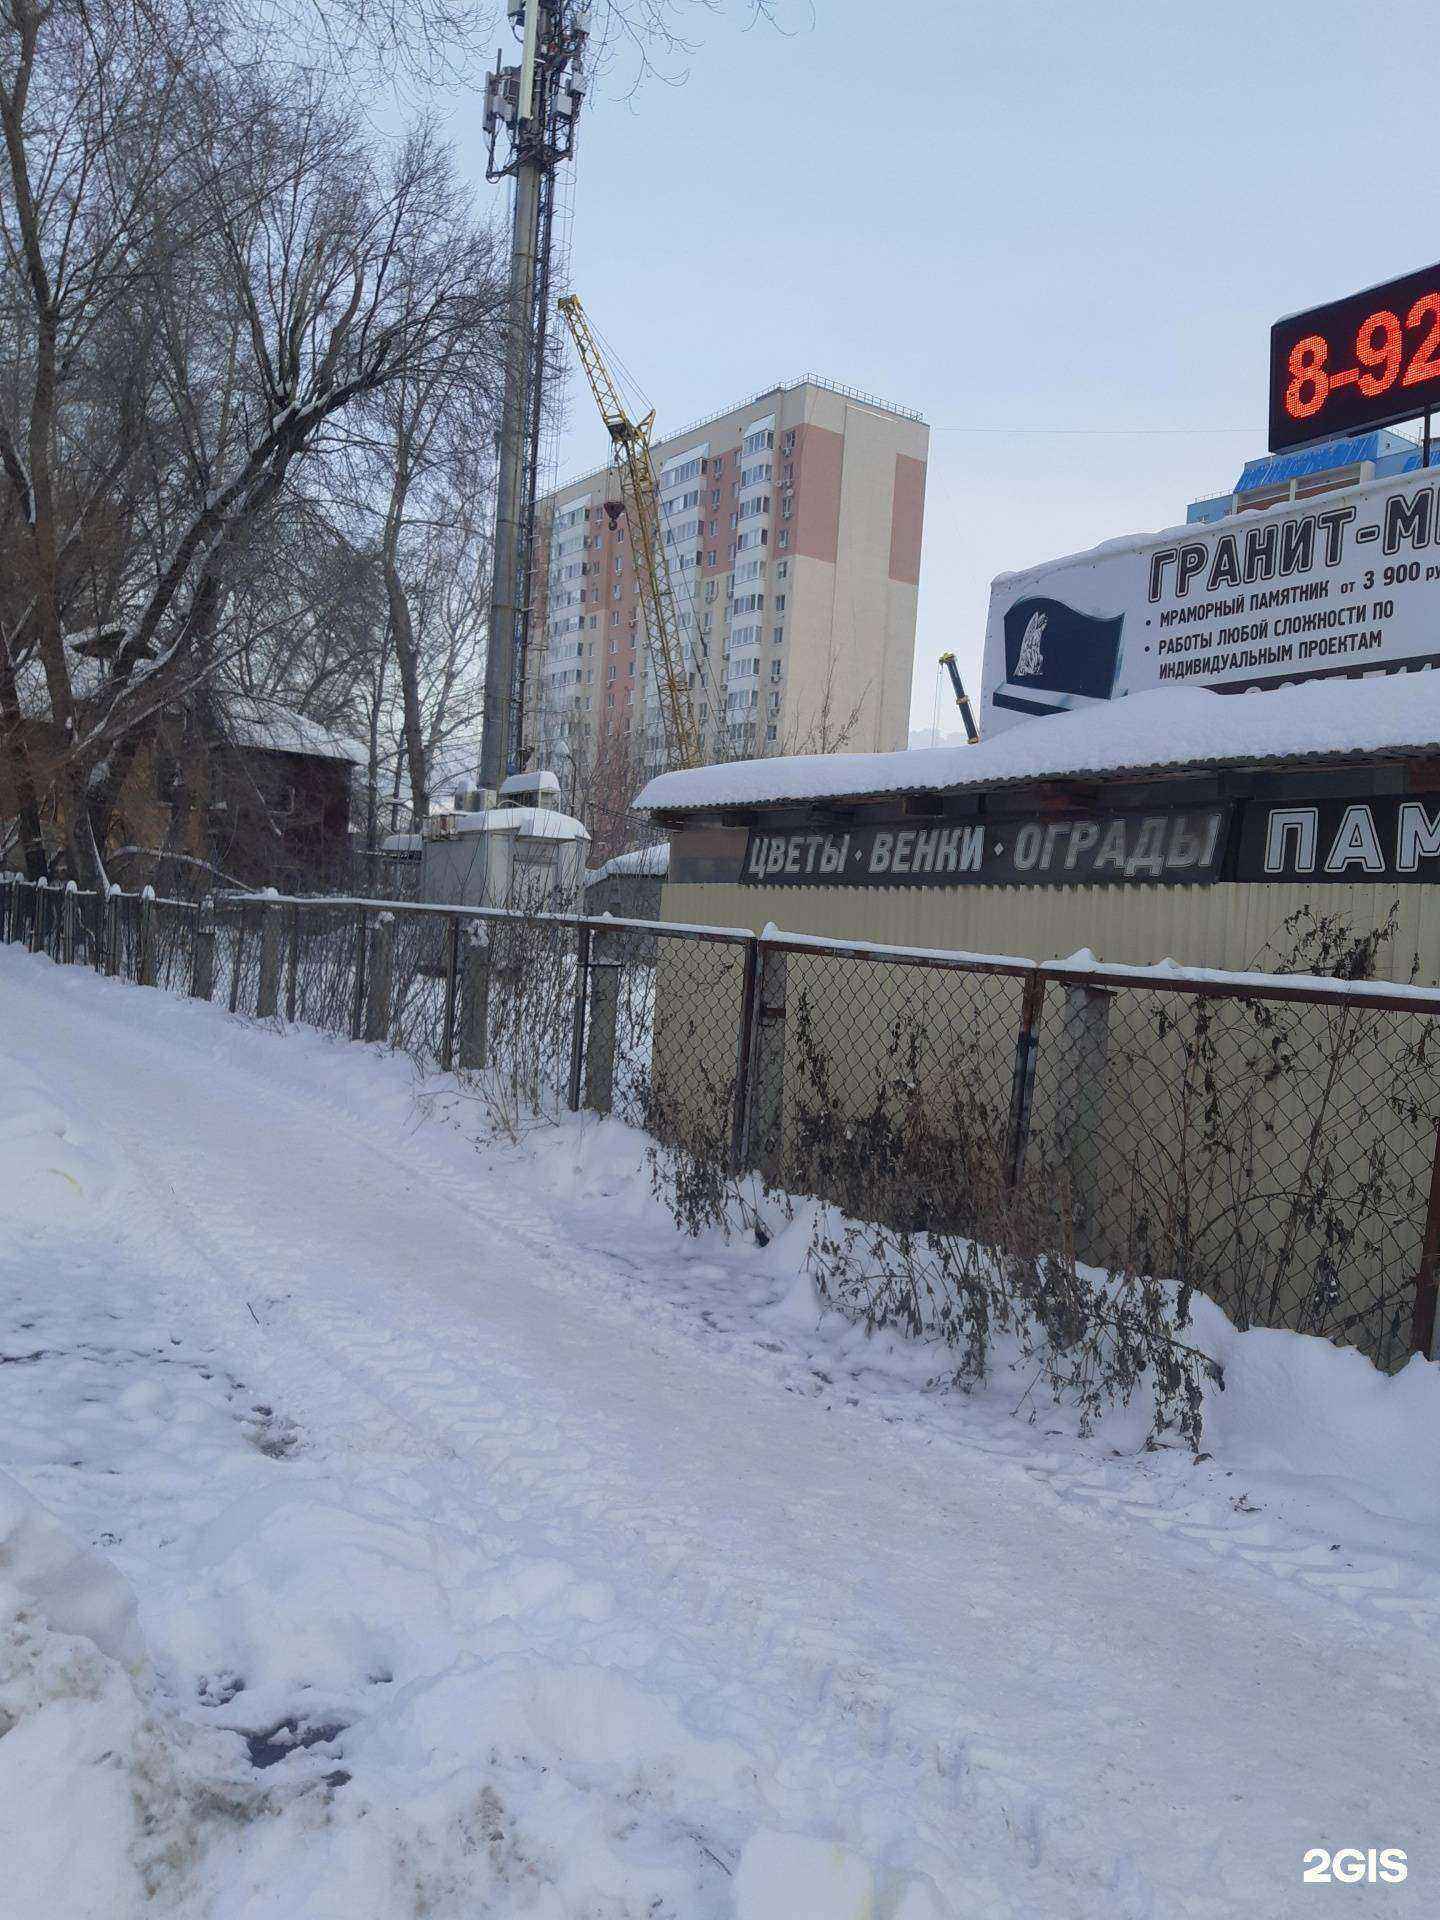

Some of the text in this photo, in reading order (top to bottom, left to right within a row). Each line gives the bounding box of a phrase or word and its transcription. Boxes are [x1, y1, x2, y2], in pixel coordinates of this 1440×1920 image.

[1149, 487, 1440, 603] ГРАНИТ-М
[1160, 594, 1245, 627] МРАМОРНЫЙ
[1250, 580, 1330, 611] ПАМЯТНИК
[1363, 570, 1375, 590] 3
[1383, 561, 1421, 586] 900
[1159, 600, 1394, 655] РАБОТЫ ЛЮБОЙ СЛОЖНОСТИ ПО
[1160, 643, 1293, 680] ИНДИВИДУАЛЬНЫМ
[1299, 629, 1382, 659] ПРОЕКТАМ
[749, 813, 1222, 880] ЦВЕТЫ ВЕНКИ ОГРАДЫ
